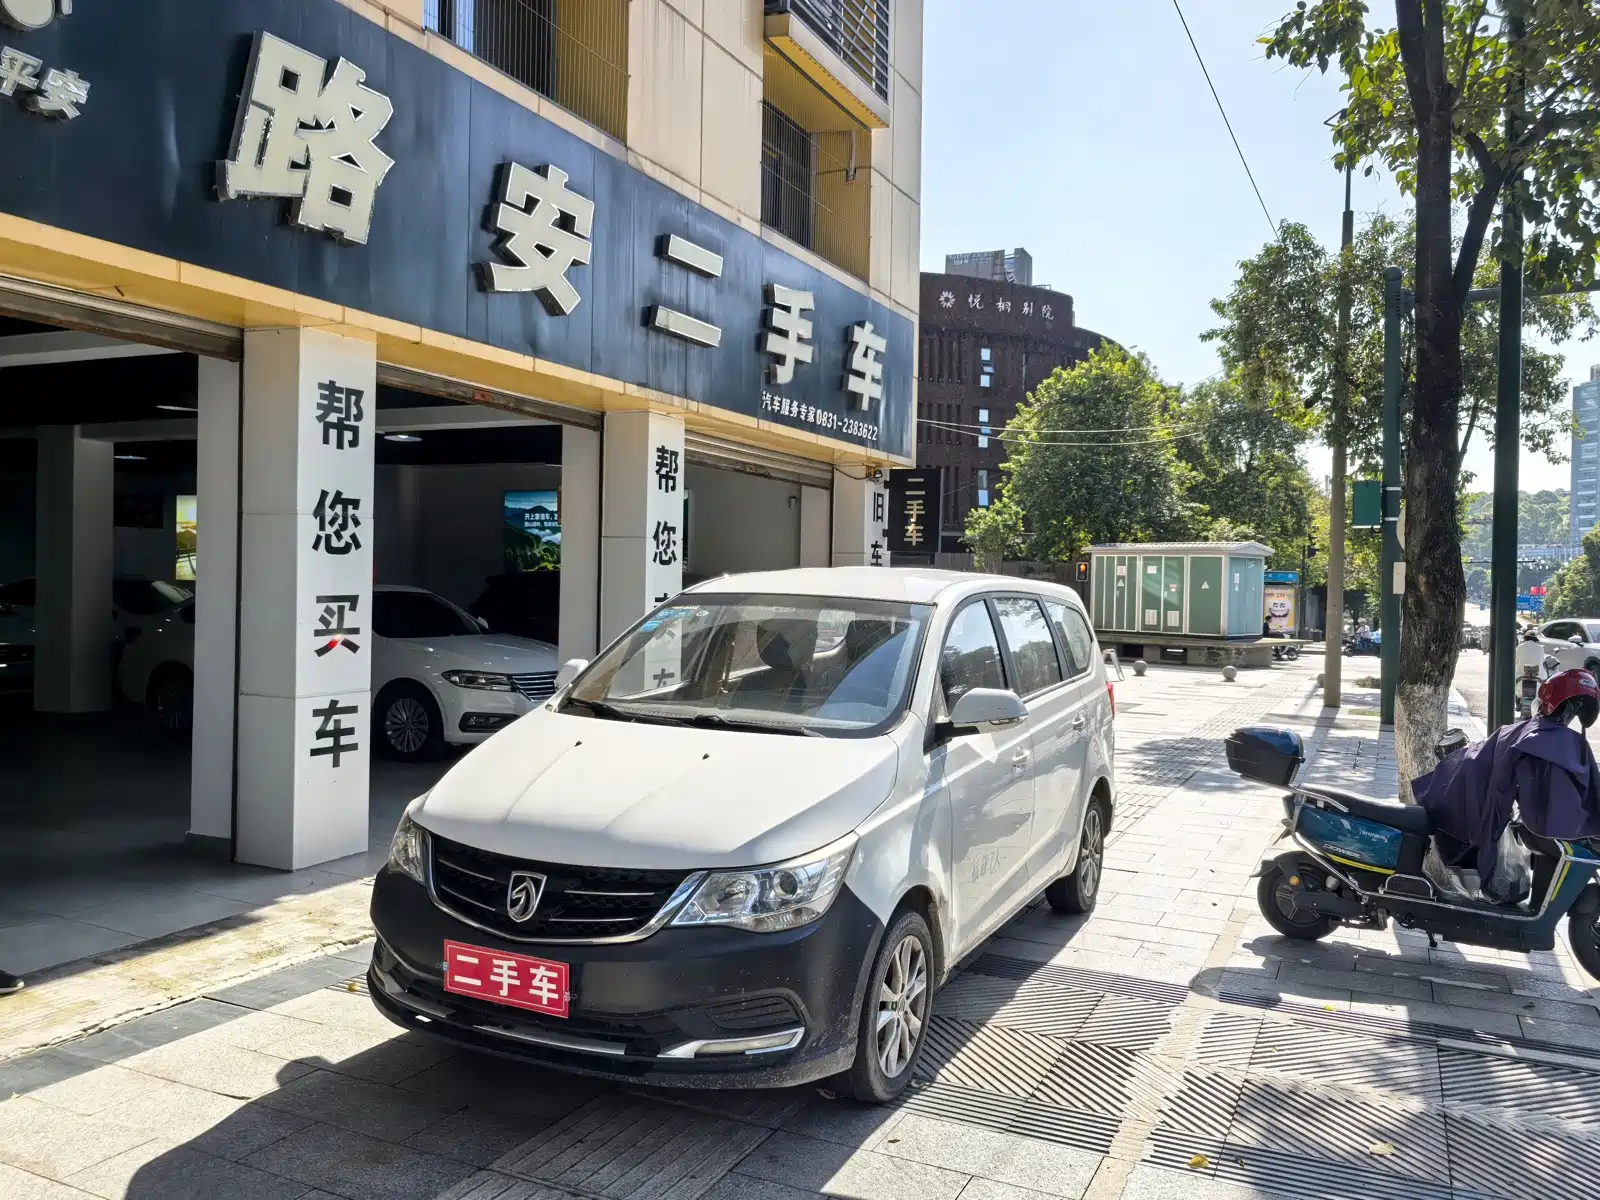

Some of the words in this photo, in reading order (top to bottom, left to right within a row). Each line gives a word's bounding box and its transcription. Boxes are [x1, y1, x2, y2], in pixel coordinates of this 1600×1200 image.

[0, 46, 91, 119] 平安
[222, 30, 886, 411] 路安二手车
[968, 293, 1054, 320] 悦桐别院
[903, 478, 926, 546] 二手车
[309, 380, 365, 768] 帮您买车
[454, 954, 559, 1005] 二手车
